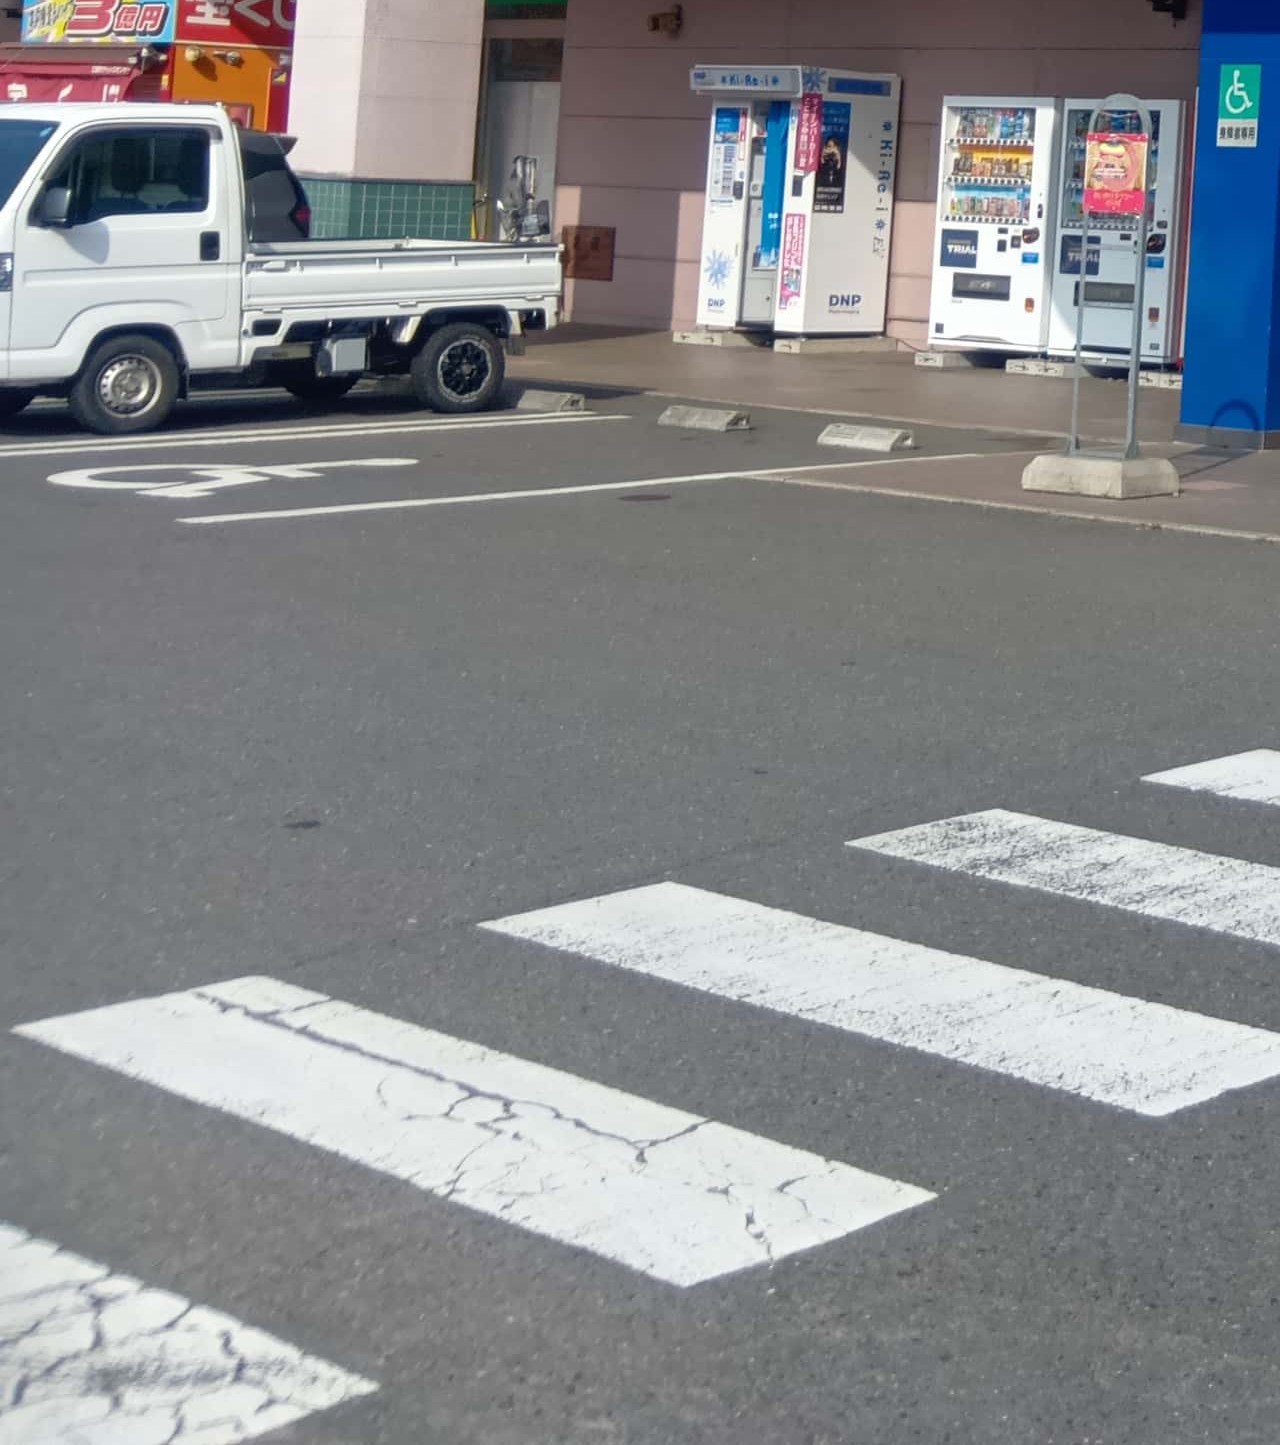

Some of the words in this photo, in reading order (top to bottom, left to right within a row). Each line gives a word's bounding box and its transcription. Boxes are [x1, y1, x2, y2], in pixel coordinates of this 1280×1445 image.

[947, 244, 977, 254] TRIAL
[707, 298, 725, 308] DNP
[829, 294, 862, 307] DNP
